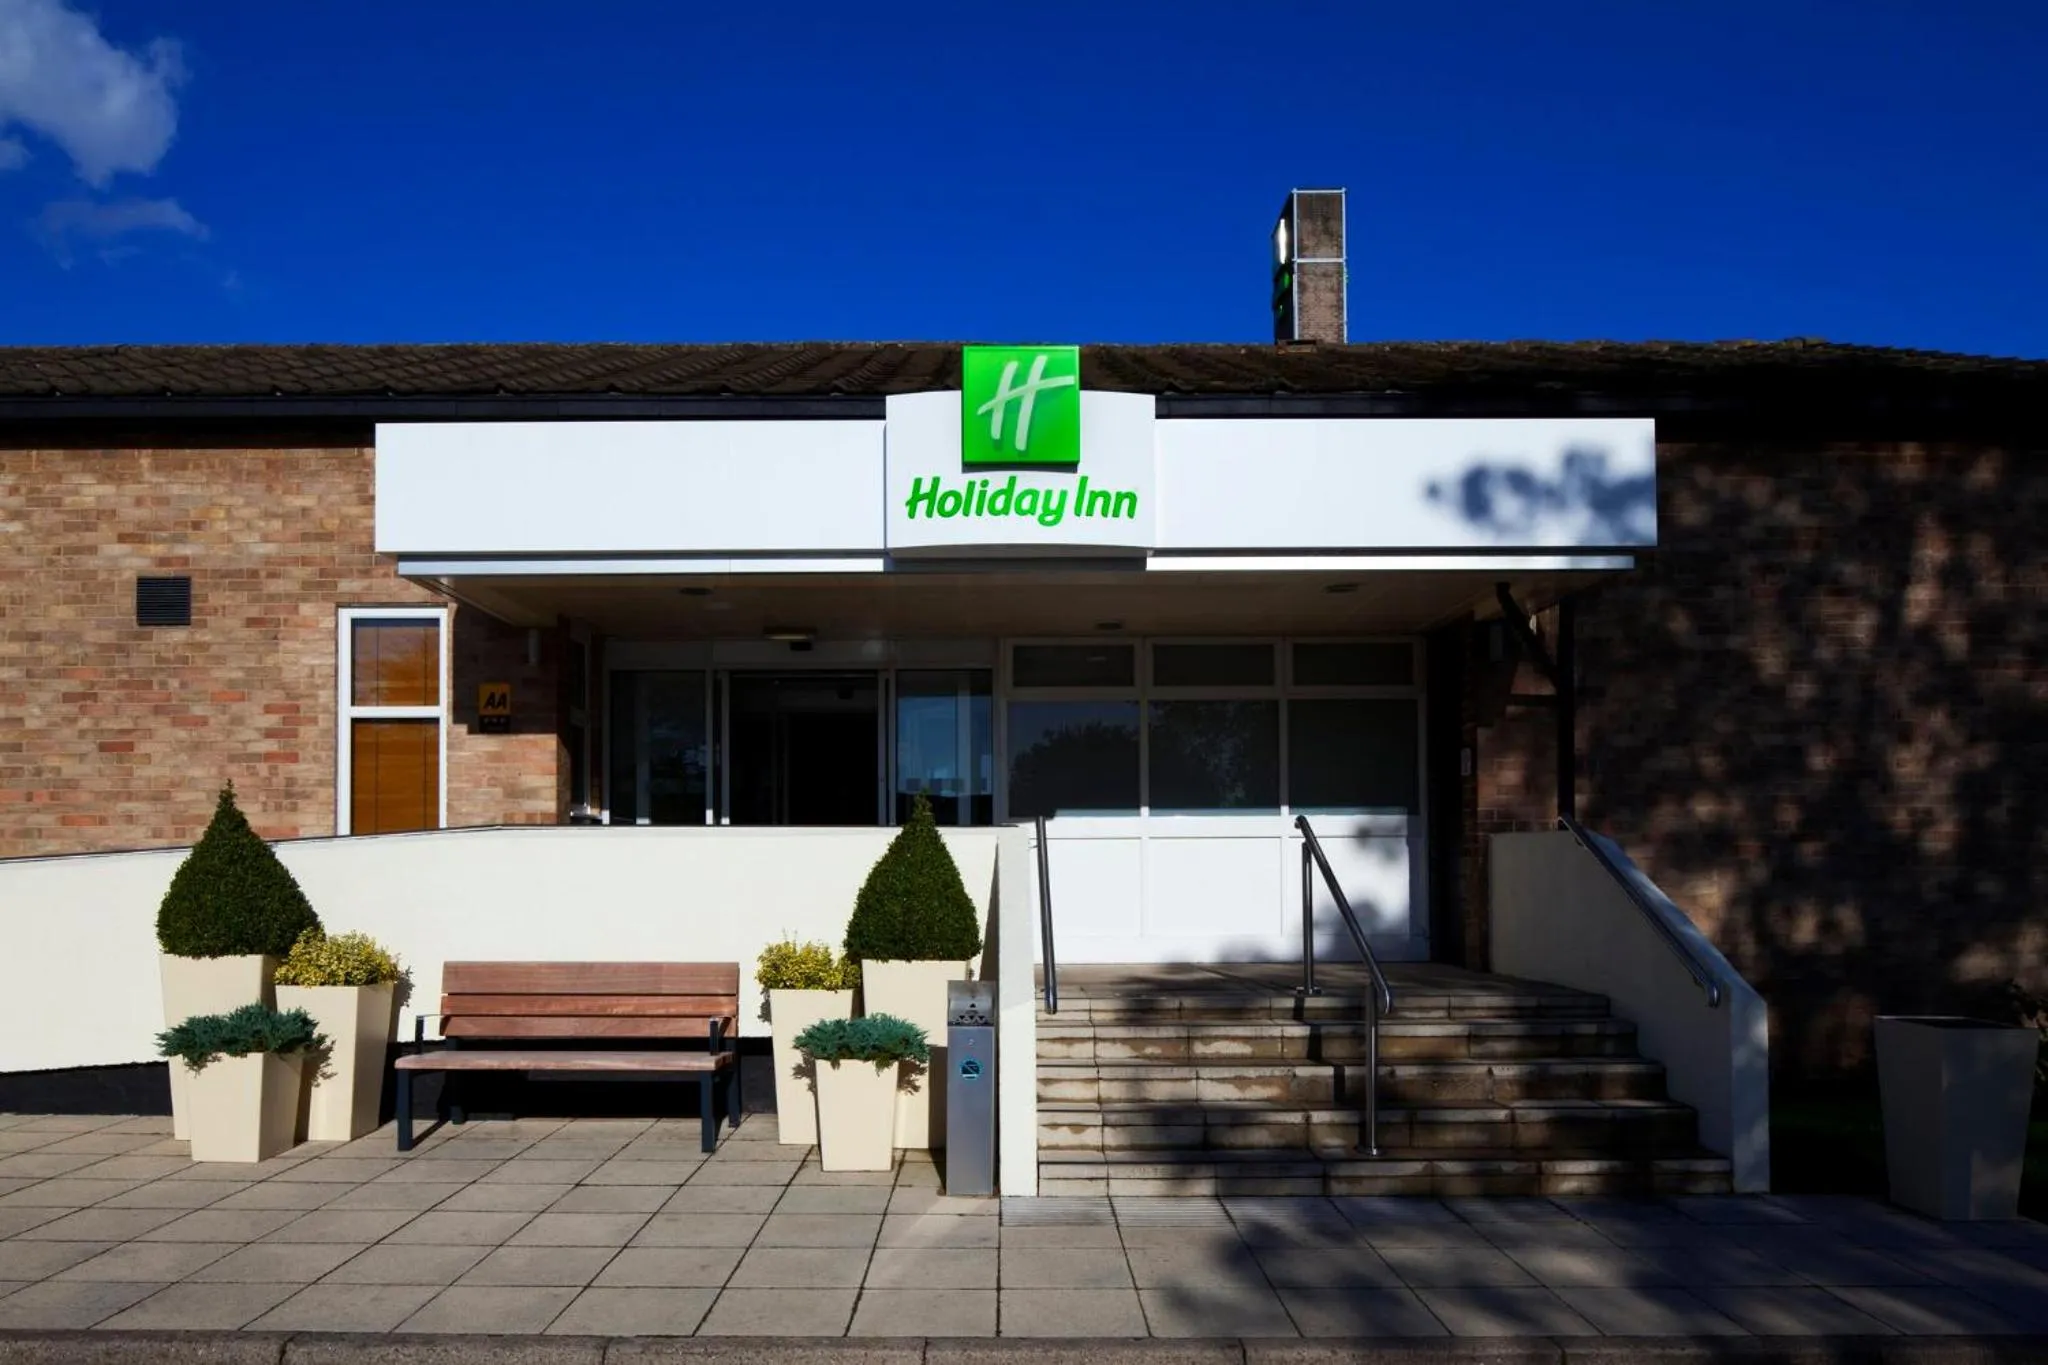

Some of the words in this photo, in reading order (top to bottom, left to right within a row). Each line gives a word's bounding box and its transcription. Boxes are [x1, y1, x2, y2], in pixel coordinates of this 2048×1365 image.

[976, 354, 1075, 451] H
[905, 475, 1069, 527] Holiday
[1074, 475, 1138, 519] Inn
[483, 691, 507, 709] AA
